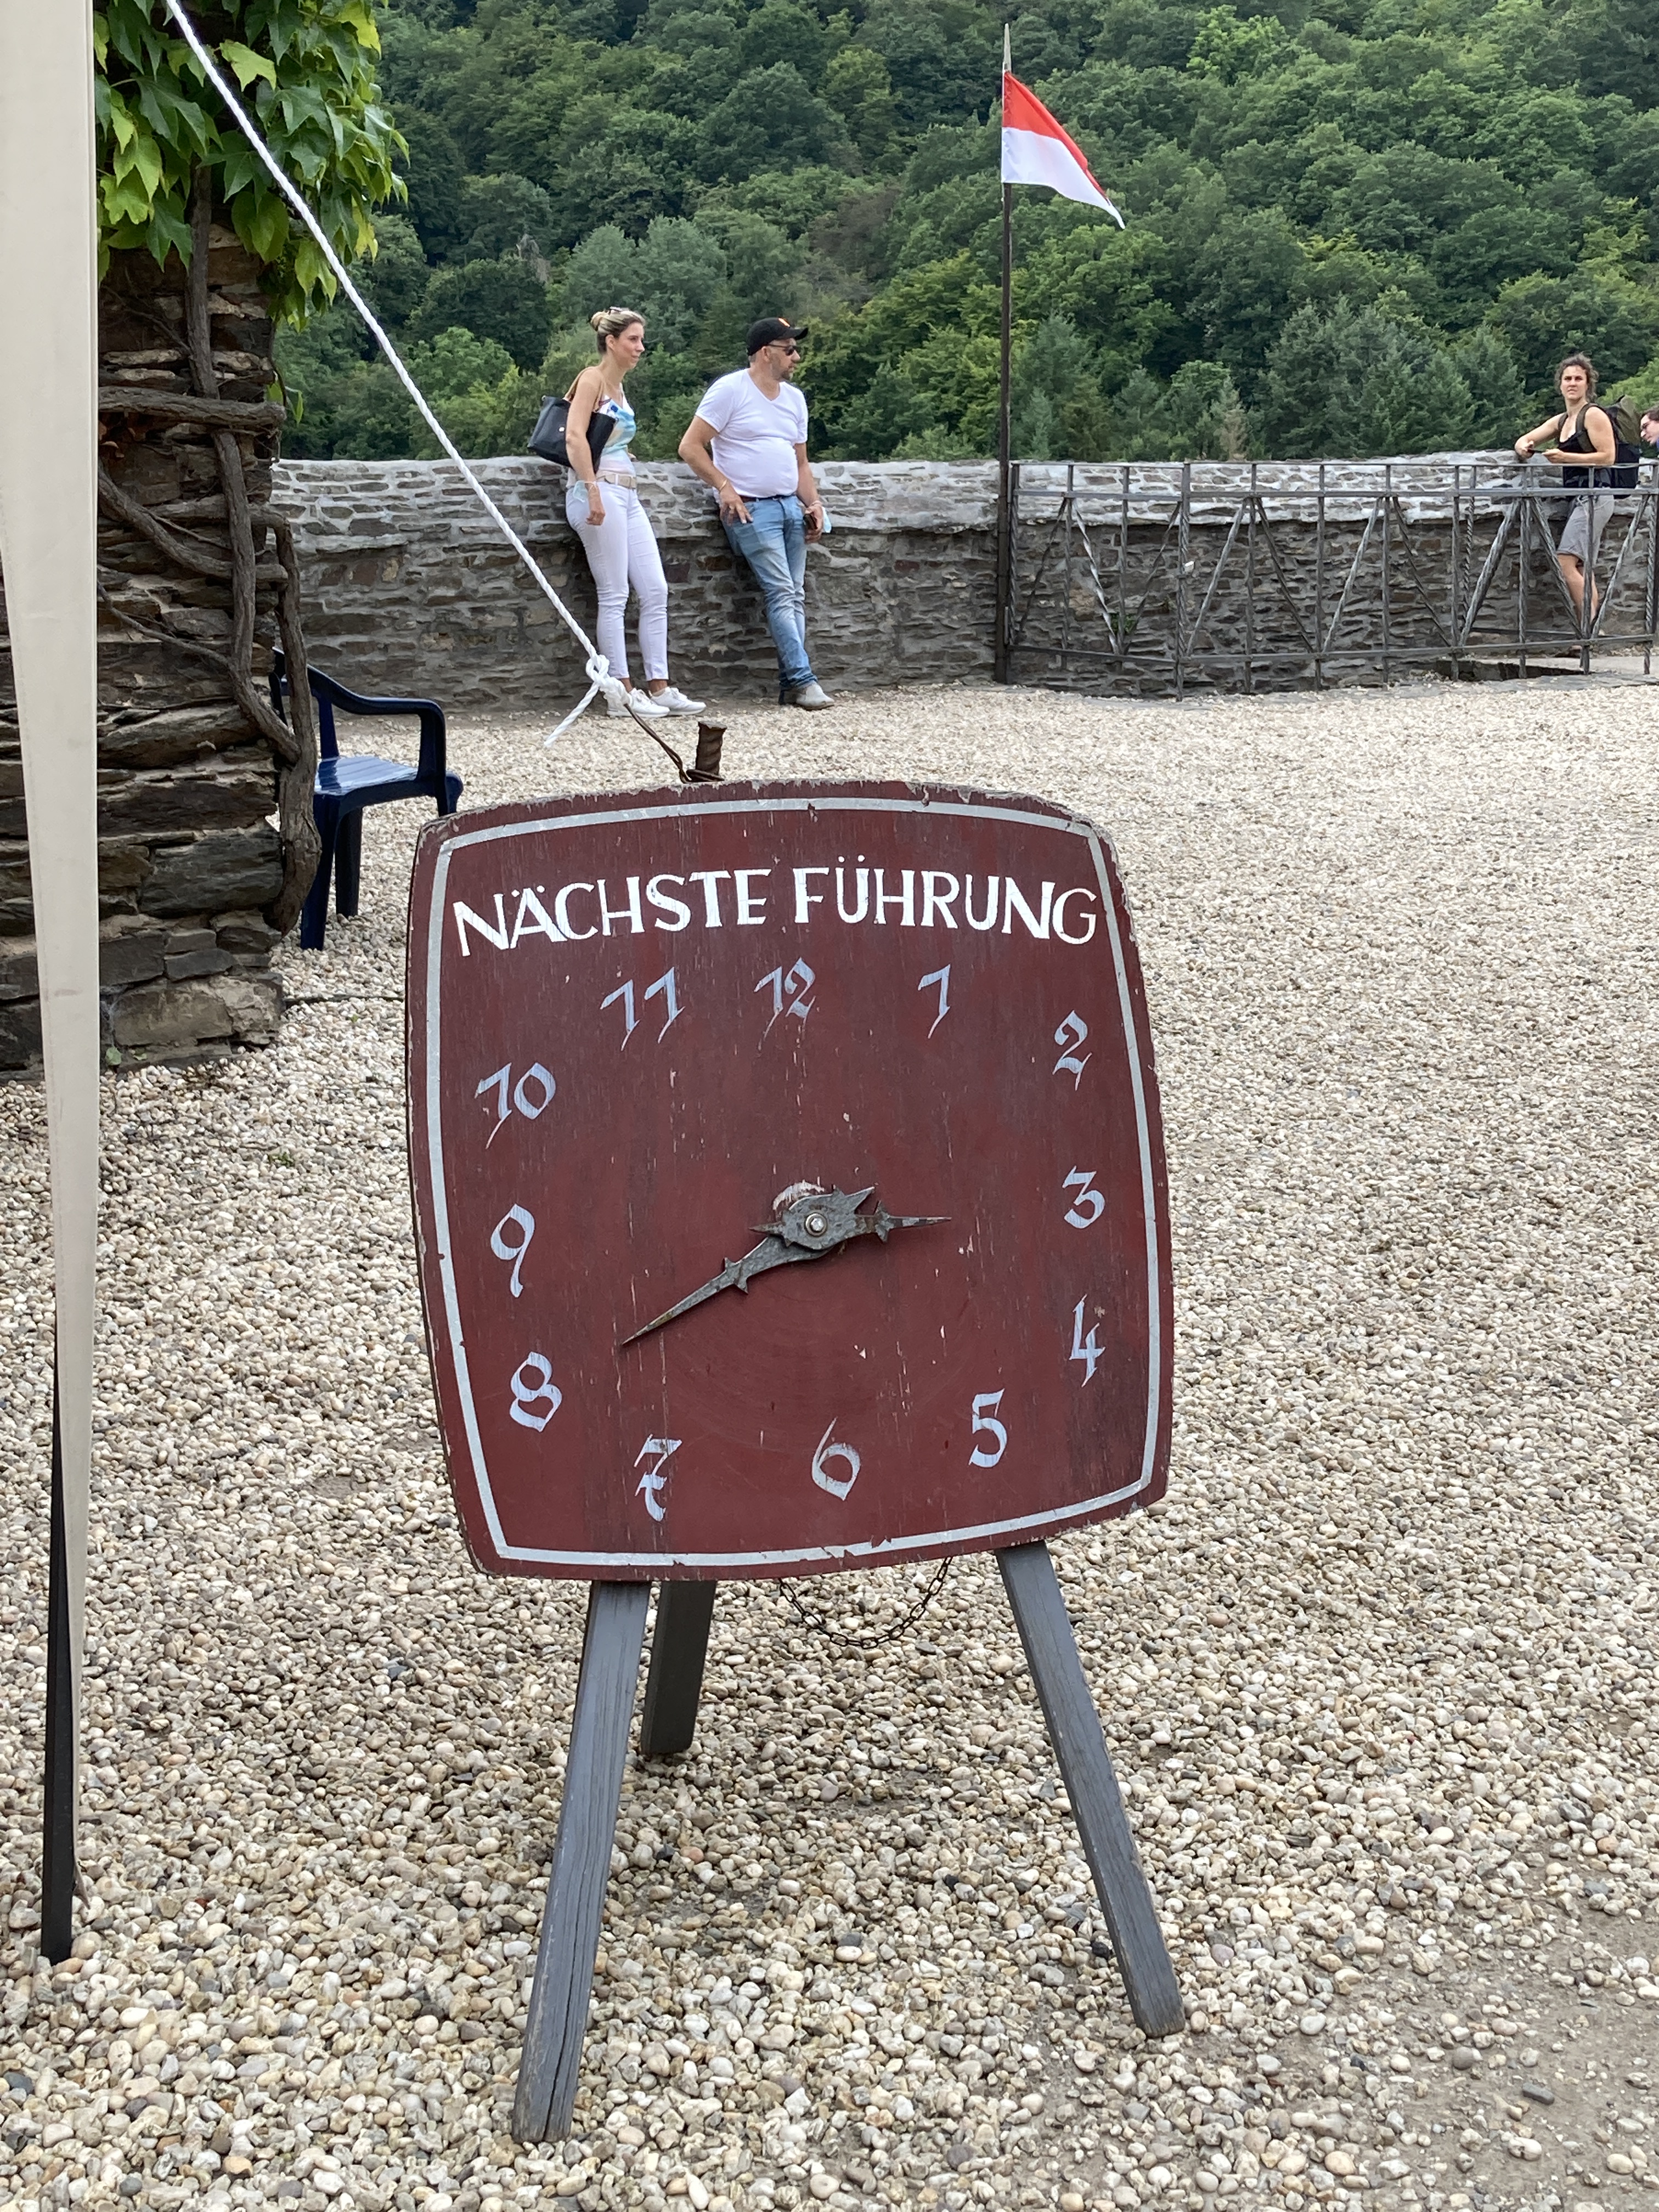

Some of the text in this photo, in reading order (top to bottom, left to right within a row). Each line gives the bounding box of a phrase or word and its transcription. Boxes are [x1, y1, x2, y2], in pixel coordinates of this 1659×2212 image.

[453, 854, 1097, 957] NÄCHSTE FÜHRUNG
[600, 966, 685, 1050] 11
[754, 957, 816, 1048] 12
[918, 964, 951, 1039] 1
[1052, 1010, 1092, 1091] 2
[474, 1062, 556, 1149] 10
[1062, 1165, 1105, 1229] 3
[490, 1204, 535, 1297] 9
[1069, 1294, 1105, 1387] 4
[509, 1351, 562, 1432] 8
[968, 1388, 1007, 1468] 5
[634, 1434, 682, 1521] 7
[811, 1418, 861, 1500] 6
